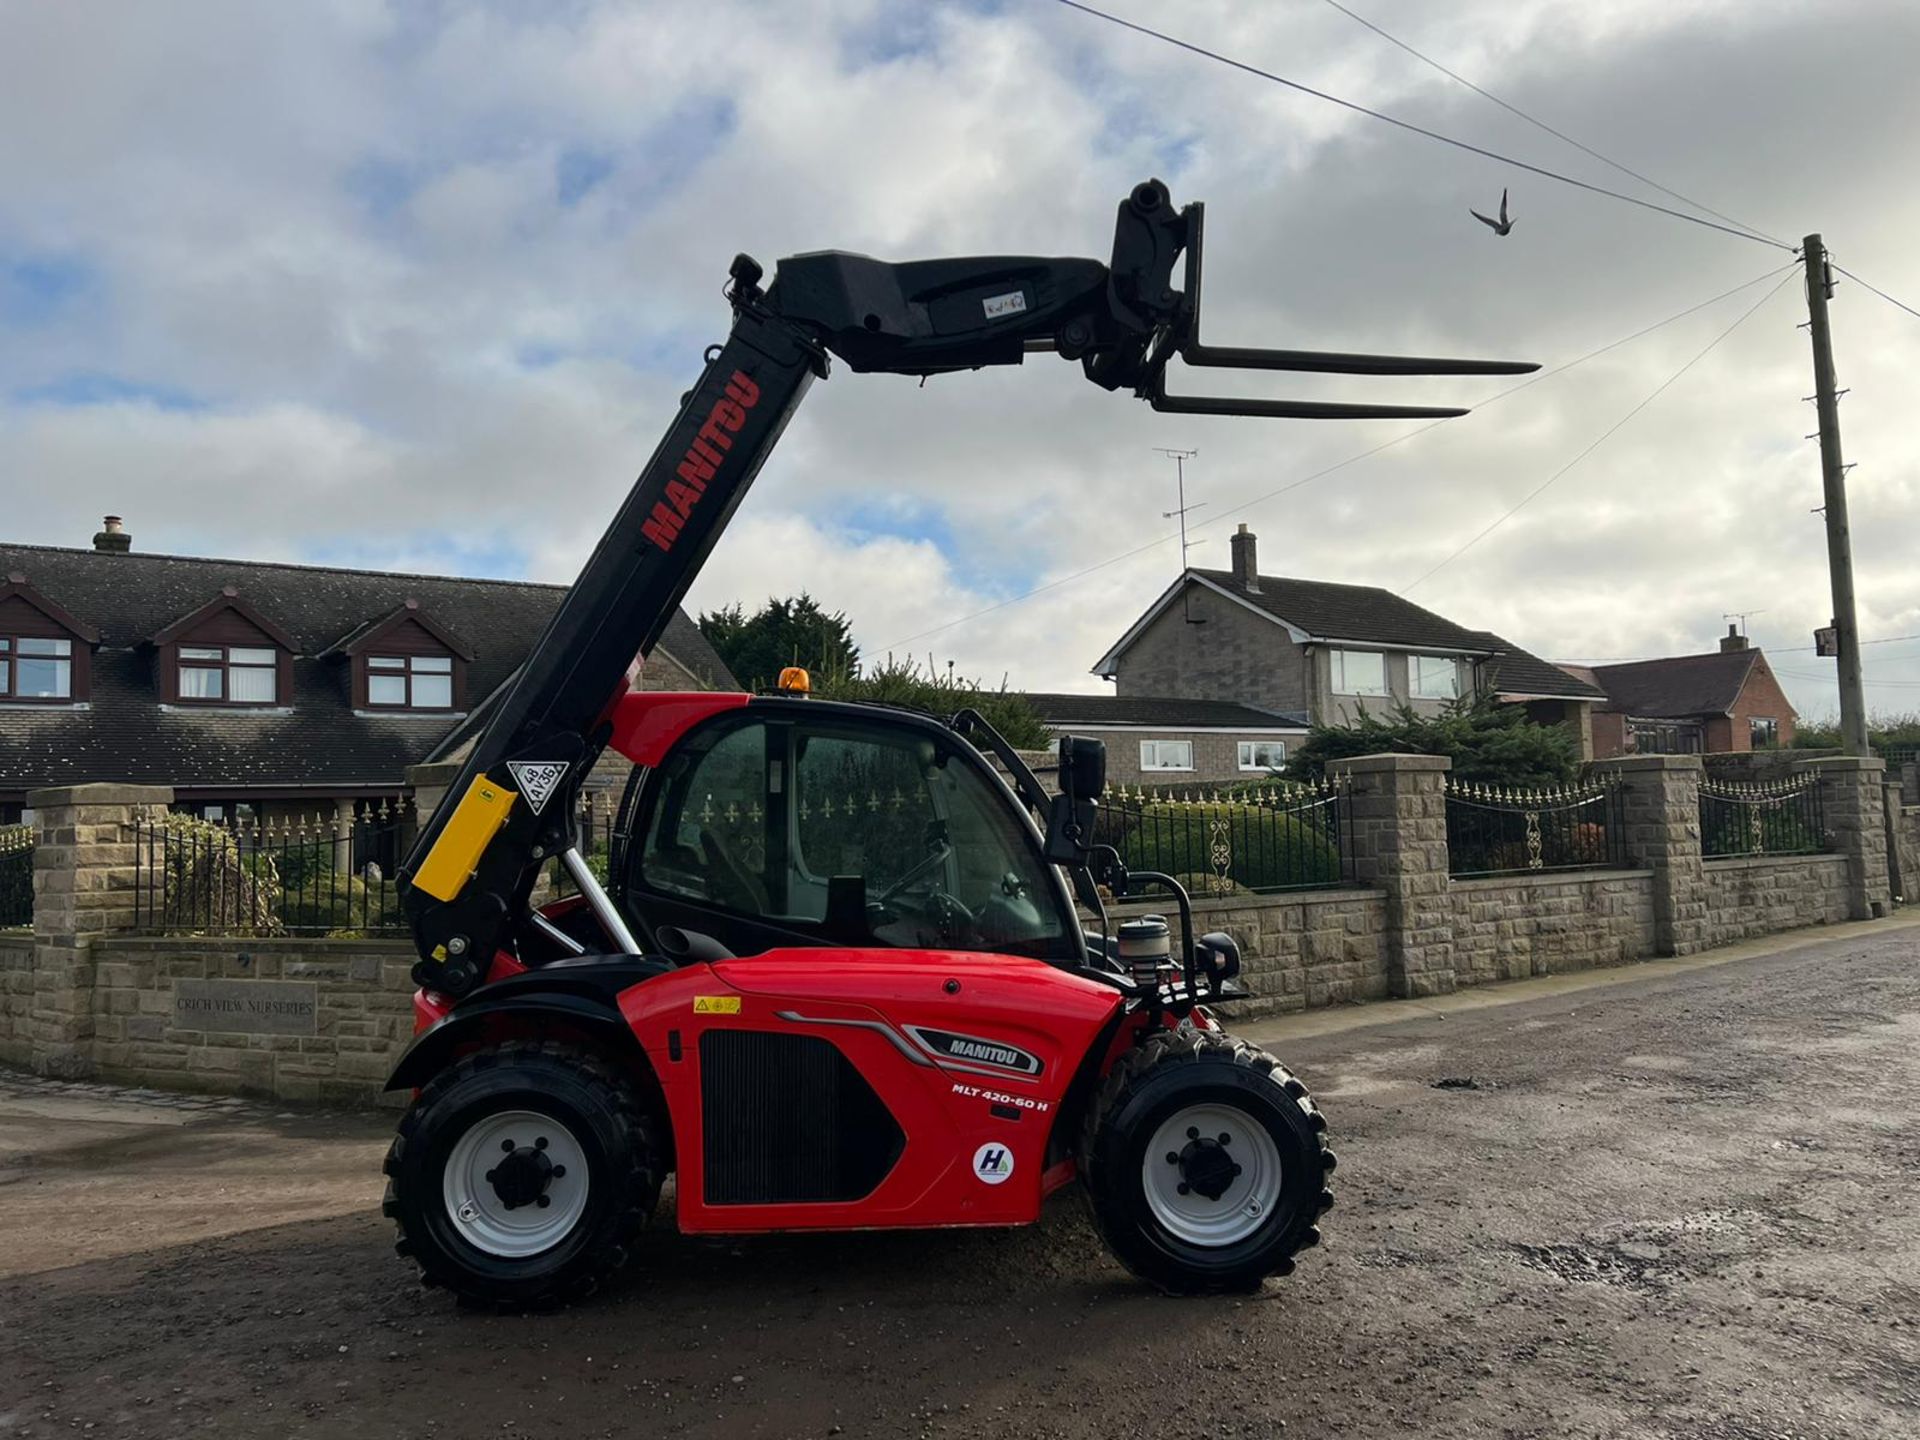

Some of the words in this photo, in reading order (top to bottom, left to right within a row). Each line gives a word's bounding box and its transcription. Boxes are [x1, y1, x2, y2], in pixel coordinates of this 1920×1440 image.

[641, 370, 760, 551] MANITOU
[523, 768, 539, 784] 48
[530, 767, 556, 799] AY3G
[177, 998, 212, 1011] CRICH
[214, 999, 243, 1013] VIEW
[247, 1000, 313, 1016] NURSERIES
[950, 1040, 1017, 1064] MANITOU
[952, 1084, 981, 1097] MLT
[981, 1090, 1035, 1109] 420-60
[1036, 1103, 1049, 1112] H
[980, 1150, 1005, 1169] H
